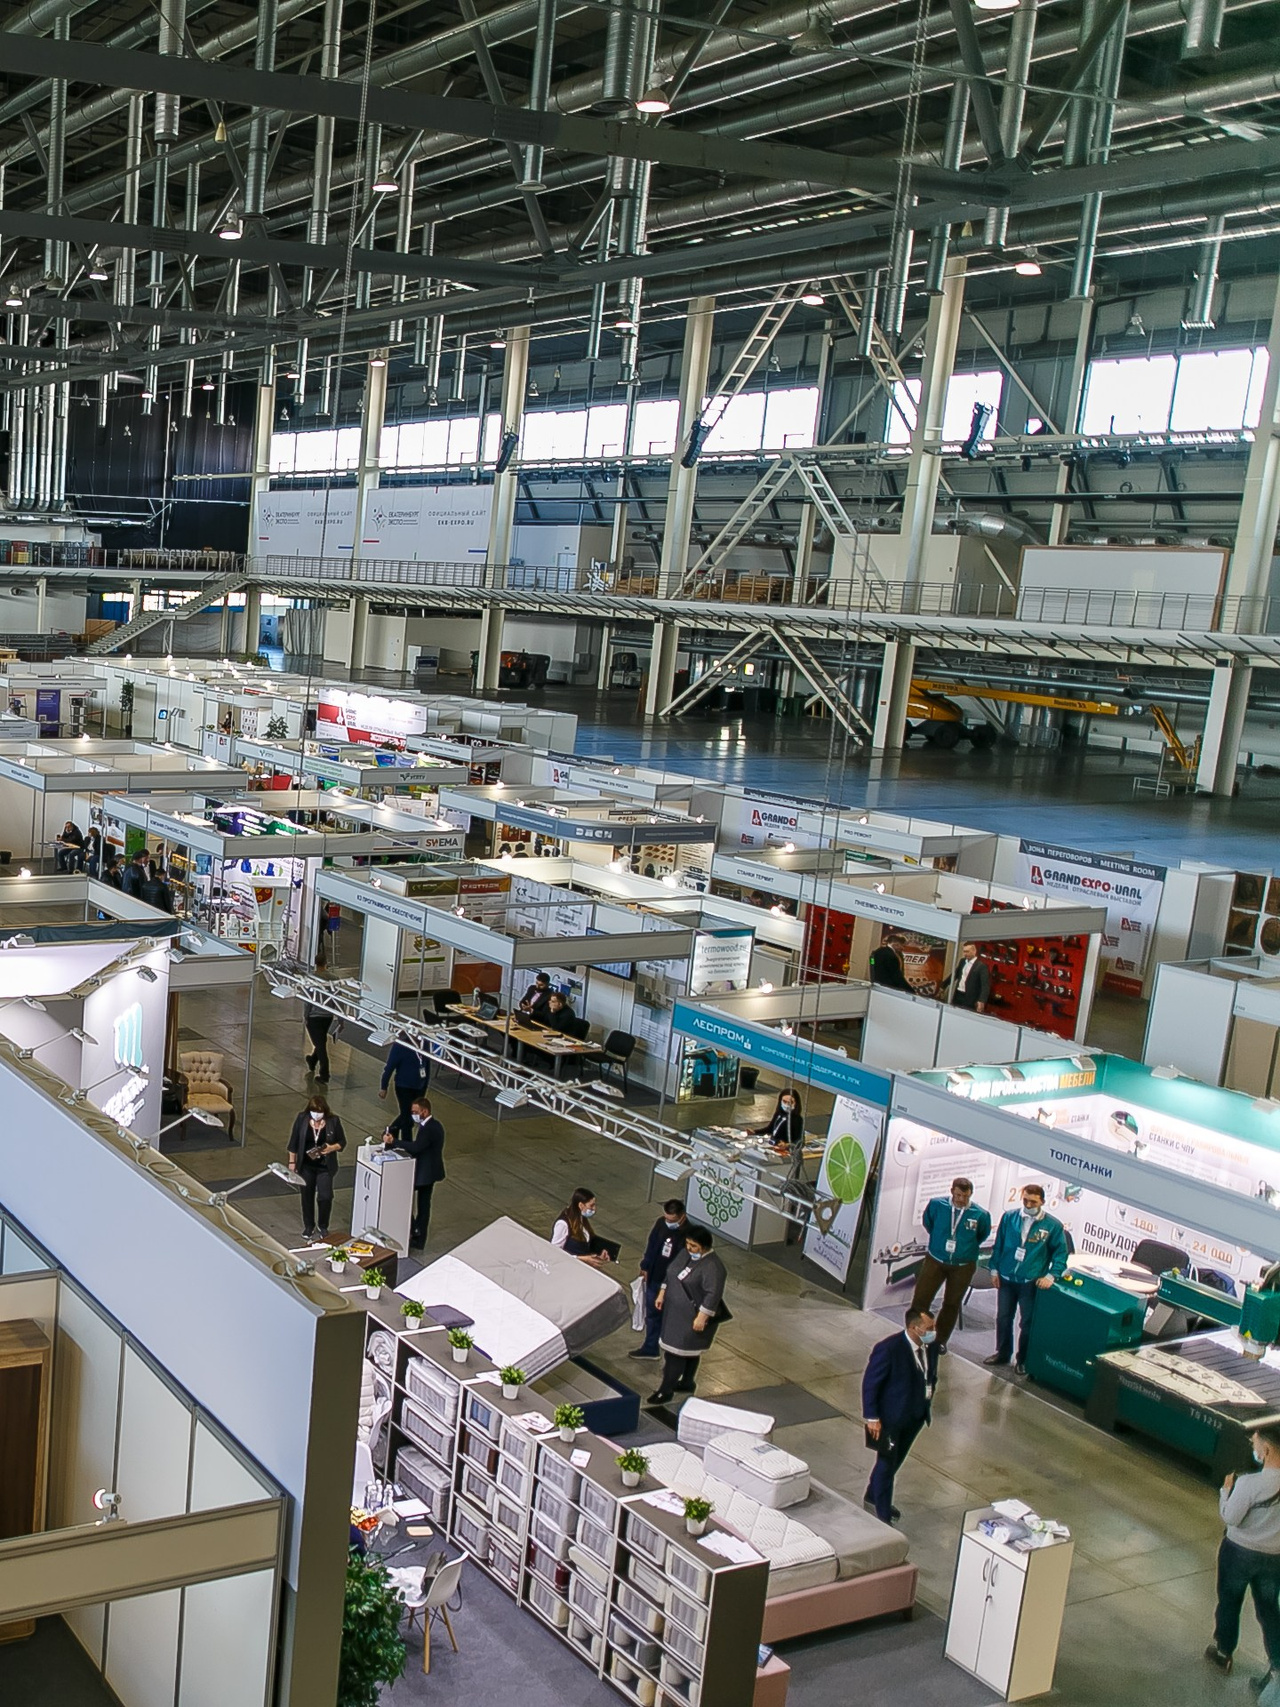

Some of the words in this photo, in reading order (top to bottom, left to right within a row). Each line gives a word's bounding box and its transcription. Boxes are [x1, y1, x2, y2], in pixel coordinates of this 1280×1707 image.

[425, 838, 459, 847] SWEMA
[853, 831, 872, 839] РЕМОНТ
[1028, 845, 1045, 855] ЗОНА
[1047, 848, 1092, 864] ПЕРЕГОВОРОВ
[1100, 859, 1130, 872] MEETING
[1133, 866, 1156, 877] ROOM
[736, 868, 755, 879] СТАНКИ
[755, 871, 774, 883] ТЕРМИТ
[1046, 881, 1069, 891] НЕДЕЛЯ
[1072, 886, 1110, 899] ОТРАСЛЕВЫХ
[1110, 894, 1142, 906] ВЫСТАВОК
[363, 896, 392, 912] ПРОГРАММНОЕ
[391, 906, 423, 924] ОБЕСПЕЧЕНИЕ
[854, 899, 905, 918] ПНЕВМО-ЭЛЕКТРО
[693, 1018, 745, 1042] ЛЕСПРОМ
[761, 1045, 806, 1065] КОМПЛЕКСНАЯ
[806, 1063, 846, 1081] ПОДДЕРЖКА
[1059, 1071, 1096, 1089] МЕБЕЛИ
[1071, 1114, 1090, 1124] СТАНКИ
[1148, 1132, 1174, 1147] СТАНКИ
[1175, 1141, 1180, 1149] С
[1181, 1144, 1195, 1155] ЧПУ
[1049, 1148, 1113, 1179] ТОПСТАНКИ
[1084, 1221, 1138, 1253] ОБОРУДОВ
[1192, 1241, 1207, 1254] 24
[1210, 1248, 1233, 1264] 000
[1189, 1408, 1201, 1421] TS
[1202, 1414, 1223, 1430] 1212
